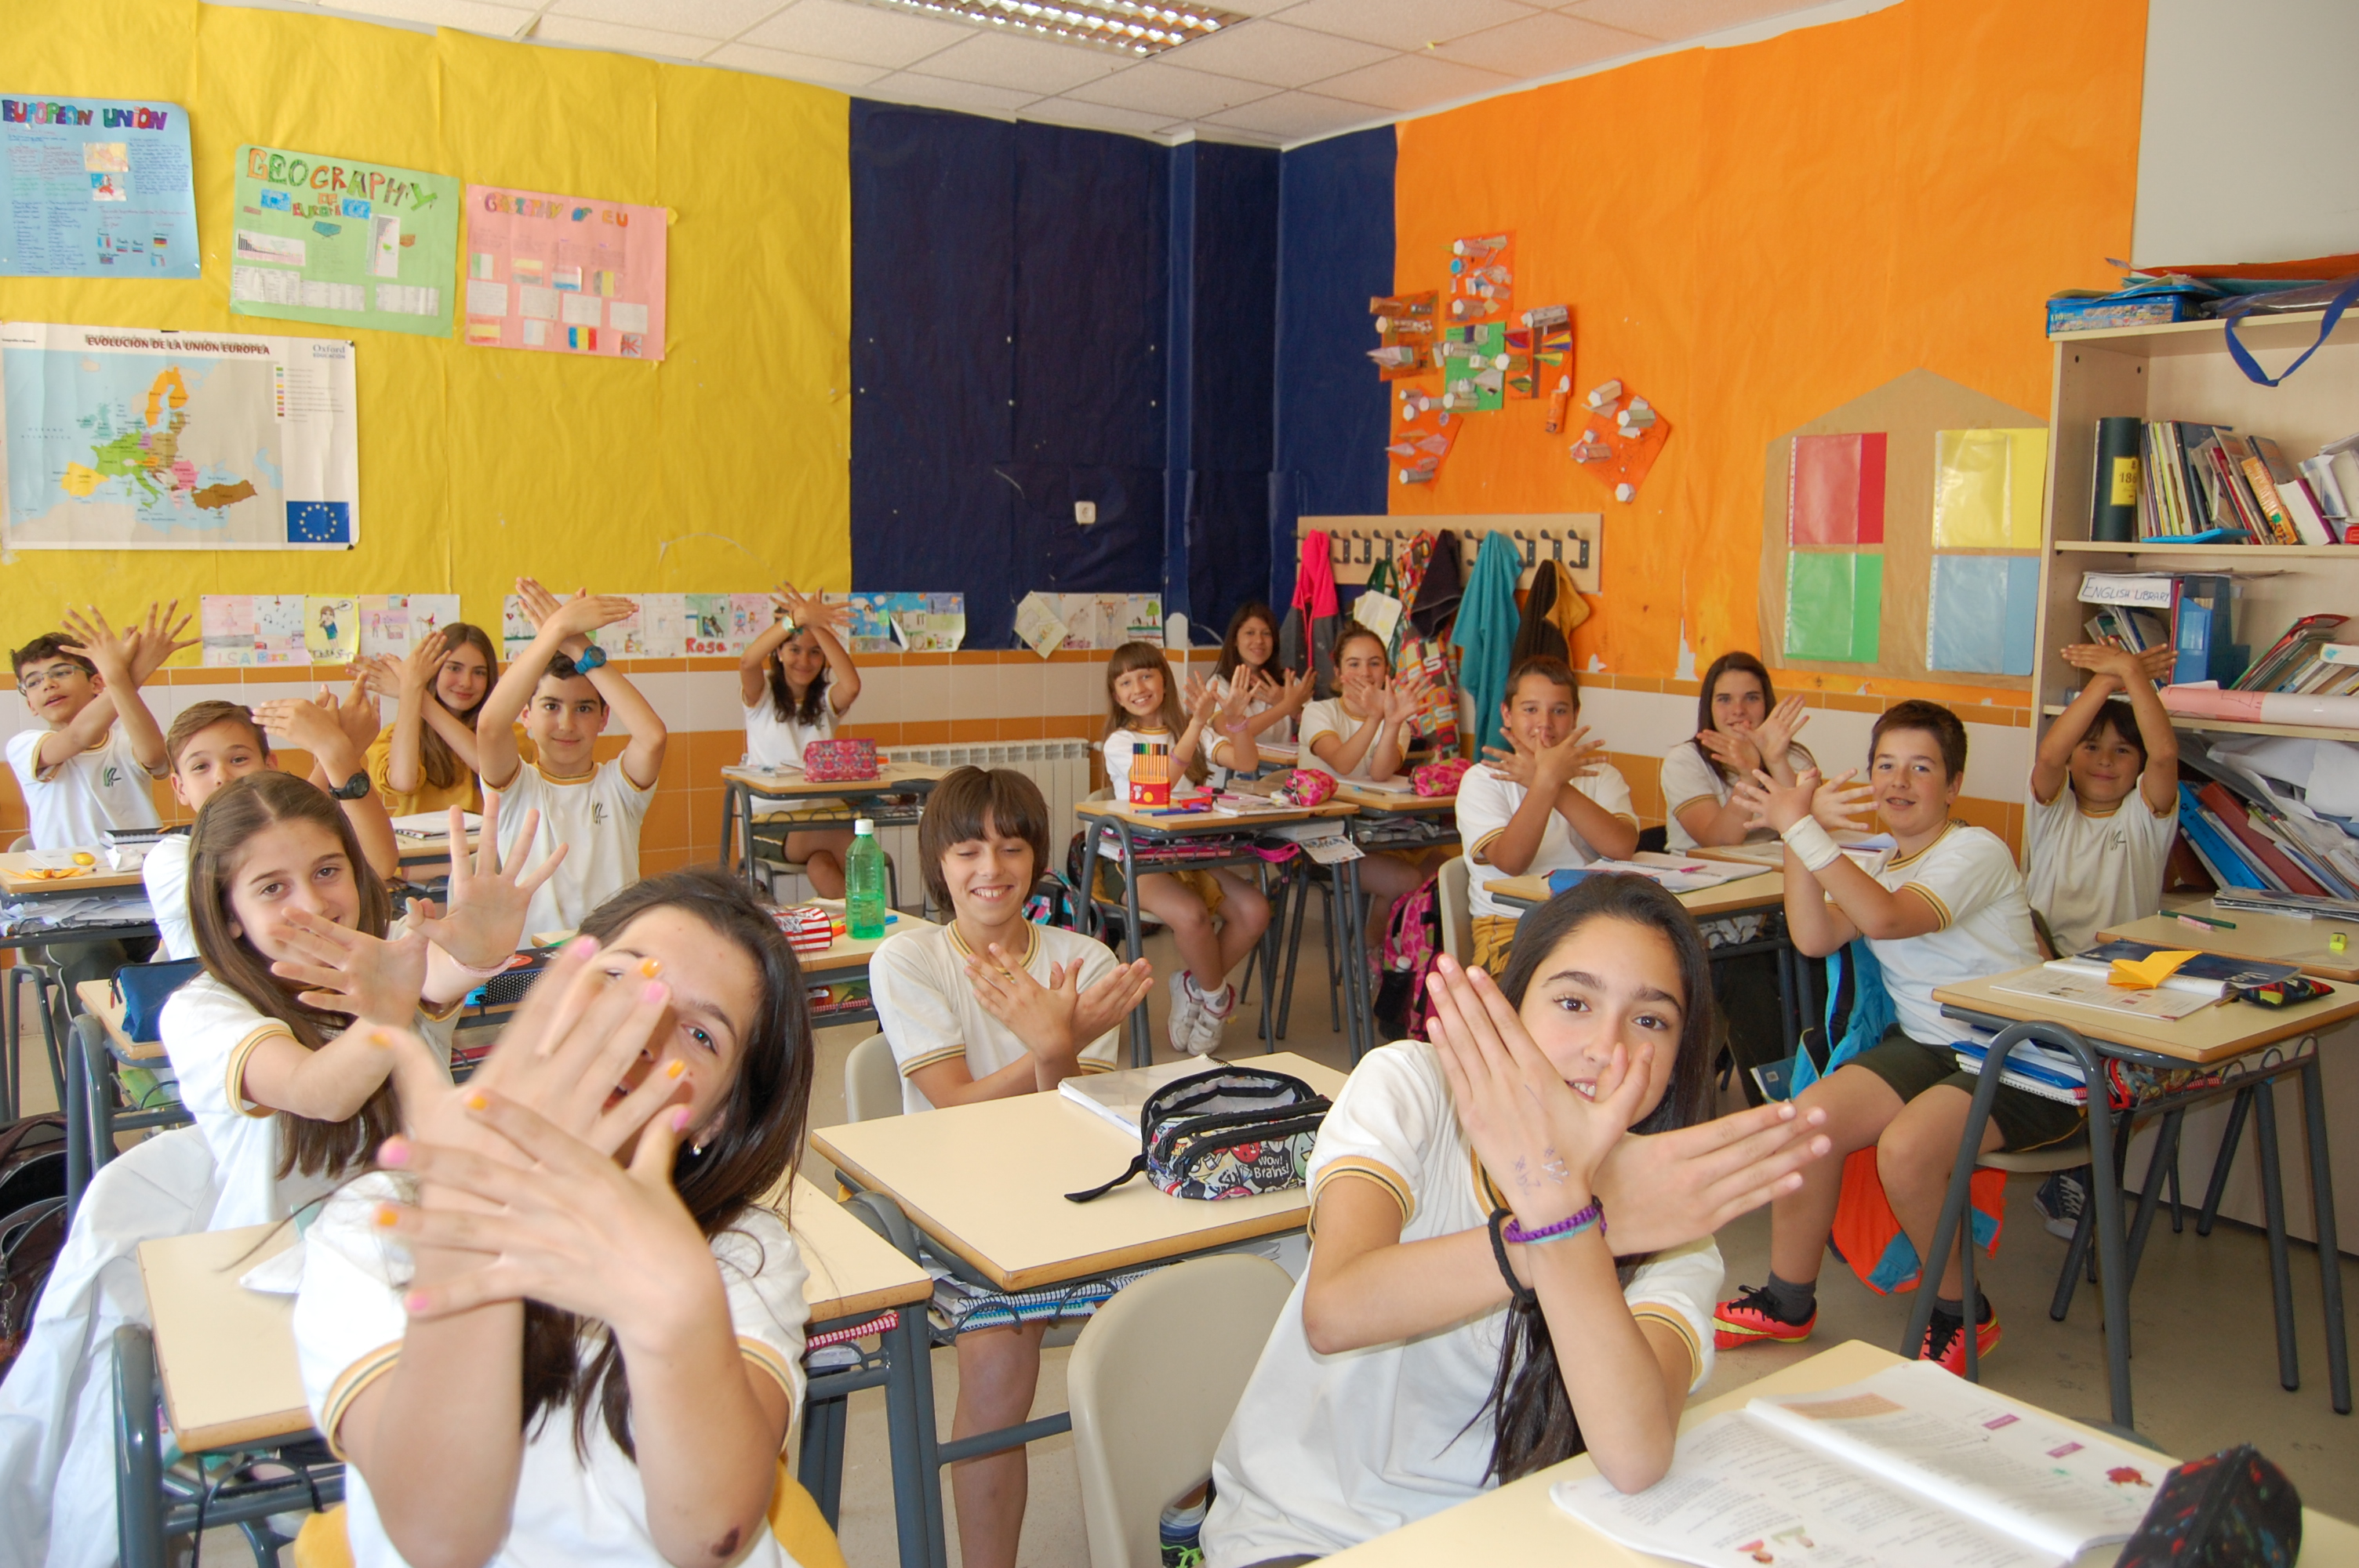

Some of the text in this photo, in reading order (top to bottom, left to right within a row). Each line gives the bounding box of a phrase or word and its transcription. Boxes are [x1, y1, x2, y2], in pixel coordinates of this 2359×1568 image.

[247, 148, 438, 211] GEOGRAPHY
[318, 192, 337, 205] OF
[602, 210, 629, 227] EU
[87, 336, 270, 354] EVOLUCIÓN DE LA UNIÓN EUROPEA
[313, 344, 345, 354] Oxford
[2082, 577, 2130, 599] ENGLISH
[1254, 1163, 1289, 1179] Brains!
